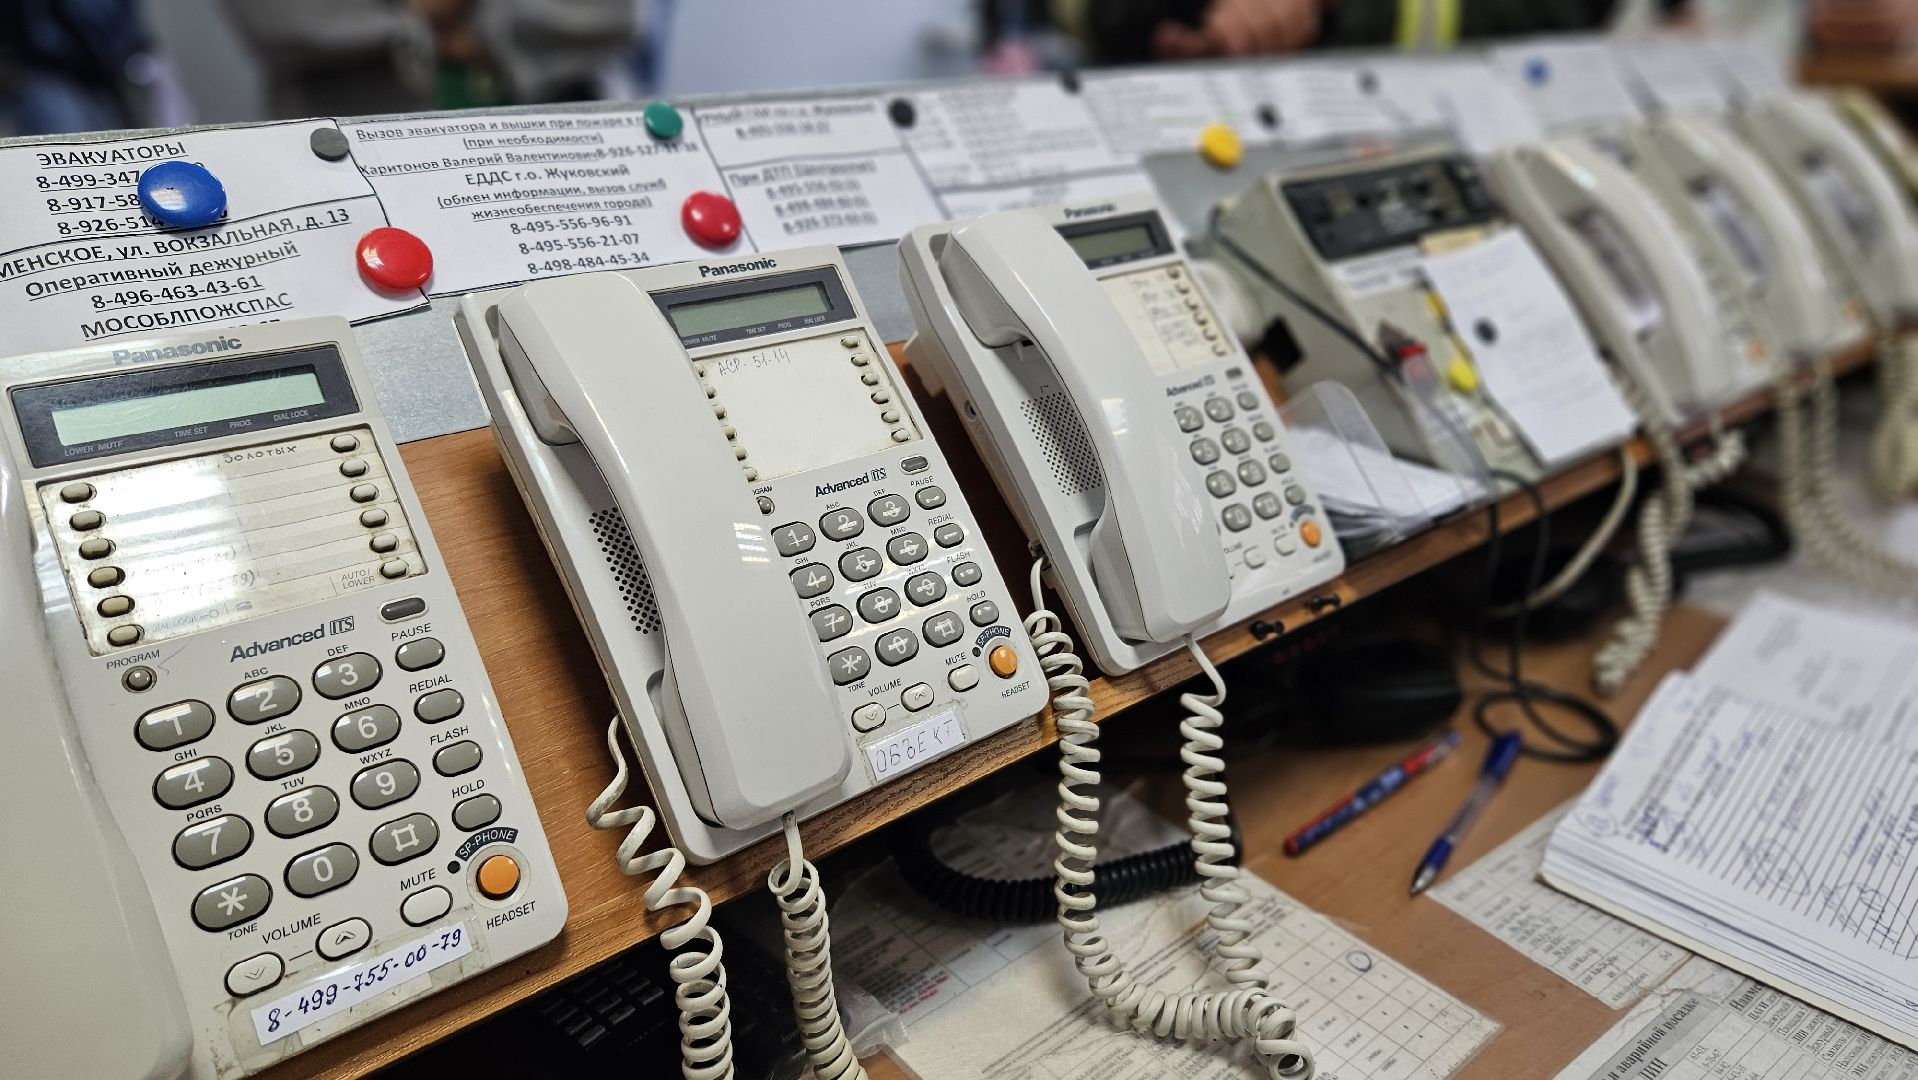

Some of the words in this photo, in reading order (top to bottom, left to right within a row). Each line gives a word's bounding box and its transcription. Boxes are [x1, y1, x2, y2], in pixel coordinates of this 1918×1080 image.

[356, 128, 403, 140] Вызов
[408, 121, 486, 137] эвакуатора
[489, 121, 498, 130] и
[501, 118, 547, 130] вышки
[550, 118, 574, 130] при
[463, 137, 495, 150] (при
[498, 132, 605, 148] необходимости)
[36, 141, 187, 167] ЭВАКУАТОРЫ
[442, 152, 502, 168] Валерий
[465, 170, 512, 187] ЕДДС
[545, 164, 631, 181] Жуковский
[437, 192, 490, 208] (обмен
[494, 184, 587, 202] информации,
[588, 182, 626, 194] вызов
[472, 200, 602, 220] жизнеобеспечения
[604, 195, 653, 210] города)
[115, 245, 150, 260] ул.
[153, 217, 300, 256] ВОКЗАЛЬНАЯ,
[306, 216, 324, 229] д.
[327, 208, 350, 224] 13
[510, 214, 633, 235] 8-495-556-96-91
[518, 233, 640, 255] 8-495-556-21-07
[25, 262, 184, 297] Оперативный
[189, 240, 298, 278] дежурный
[527, 251, 651, 275] 8-498-484-45-34
[698, 257, 777, 278] Panasonic
[91, 274, 264, 310] 8-496-463-43-61
[80, 292, 293, 338] МОСОБЛПОЖСПАС
[111, 335, 242, 366] Panasonic
[273, 411, 288, 421] DIAL
[289, 408, 308, 419] LOCK
[174, 427, 193, 438] TIME
[194, 425, 208, 436] SET
[64, 444, 93, 456] LOWER
[98, 440, 124, 451] MUTE
[814, 472, 869, 497] Advanced
[910, 475, 934, 487] PAUSE
[826, 502, 840, 511] ABC
[838, 514, 857, 532] 2
[927, 512, 954, 527] REDIAL
[787, 529, 800, 547] 1
[890, 526, 906, 536] MNO
[846, 541, 859, 550] JKL
[795, 556, 809, 565] GHI
[855, 554, 871, 573] 5
[946, 550, 971, 564] FLASH
[342, 576, 376, 589] LOWER
[806, 570, 821, 589] 4
[921, 578, 936, 597] 9
[874, 595, 889, 614] 8
[967, 590, 986, 603] HOLD
[391, 622, 433, 642] PAUSE
[823, 612, 836, 633] 7
[230, 625, 325, 663] Advanced
[330, 616, 355, 636] ITS
[106, 649, 161, 671] PROGRAM
[327, 644, 350, 657] DEF
[945, 651, 967, 666] MUTE
[243, 667, 269, 680] ABC
[340, 663, 359, 686] 3
[409, 673, 453, 694] REDIAL
[847, 681, 866, 693] TONE
[868, 678, 902, 697] VOLUME
[1001, 680, 1031, 699] HEADSET
[255, 688, 278, 713] 2
[344, 696, 371, 710] MNO
[264, 722, 286, 736] JKL
[357, 715, 378, 739] 6
[429, 725, 470, 746] FLASH
[174, 748, 198, 762] GHI
[274, 742, 295, 767] 5
[360, 748, 393, 765] WXYZ
[183, 769, 205, 795] 4
[282, 776, 306, 791] TUV
[375, 771, 396, 796] 9
[451, 779, 485, 799] HOLD
[186, 804, 223, 822] PQRS
[292, 797, 315, 823] 8
[202, 827, 223, 857] 7
[458, 828, 517, 859] SP-PHONE
[311, 856, 335, 883] 0
[399, 868, 437, 891] MUTE
[486, 901, 537, 931] HEADSET
[227, 922, 258, 941] TONE
[261, 913, 322, 945] VOLUME
